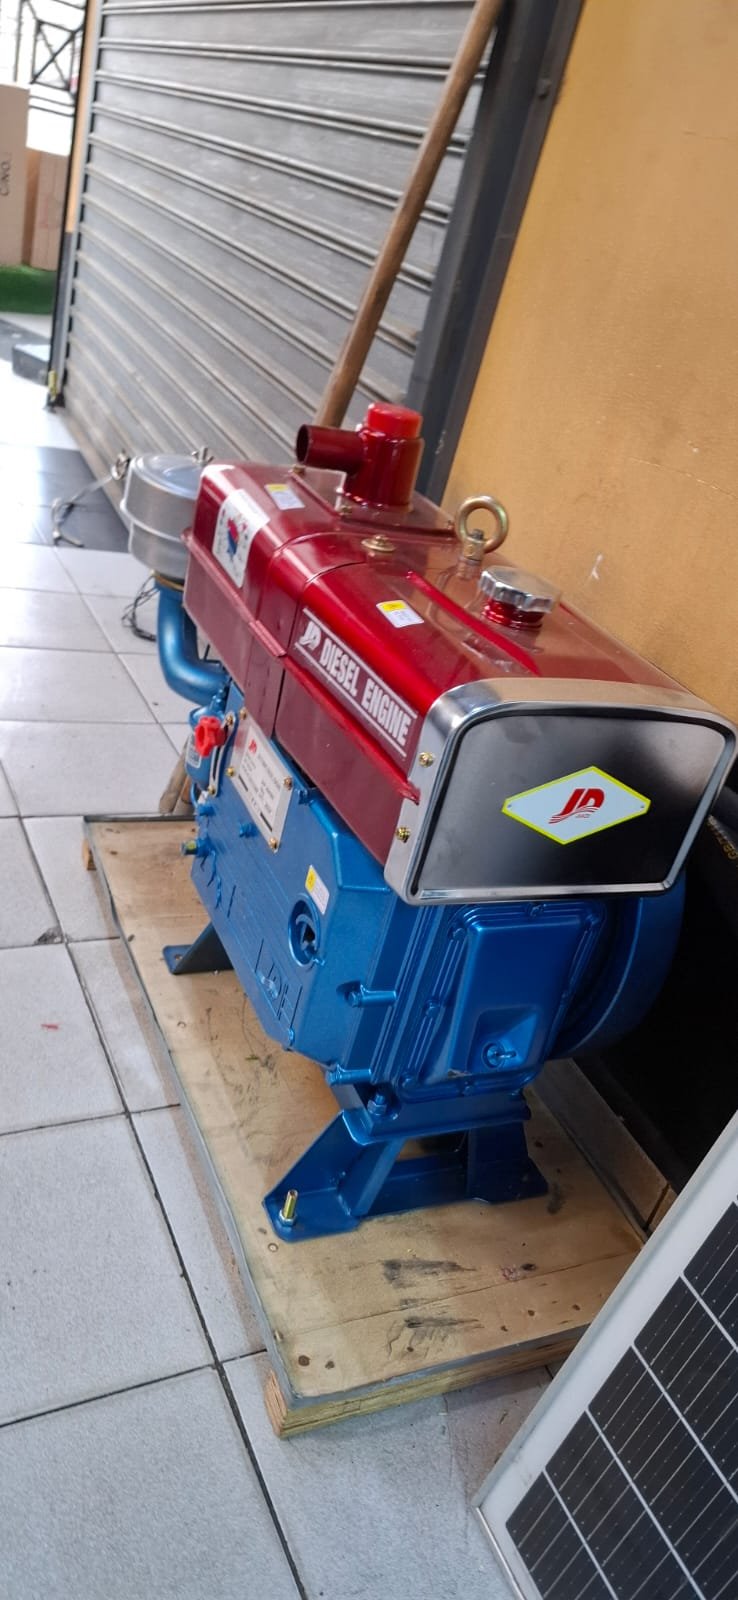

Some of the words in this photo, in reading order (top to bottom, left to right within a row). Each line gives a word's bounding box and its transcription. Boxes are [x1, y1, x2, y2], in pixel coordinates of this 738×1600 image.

[319, 637, 361, 698] DIESEL
[361, 673, 412, 747] ENGINE
[548, 787, 605, 824] JD
